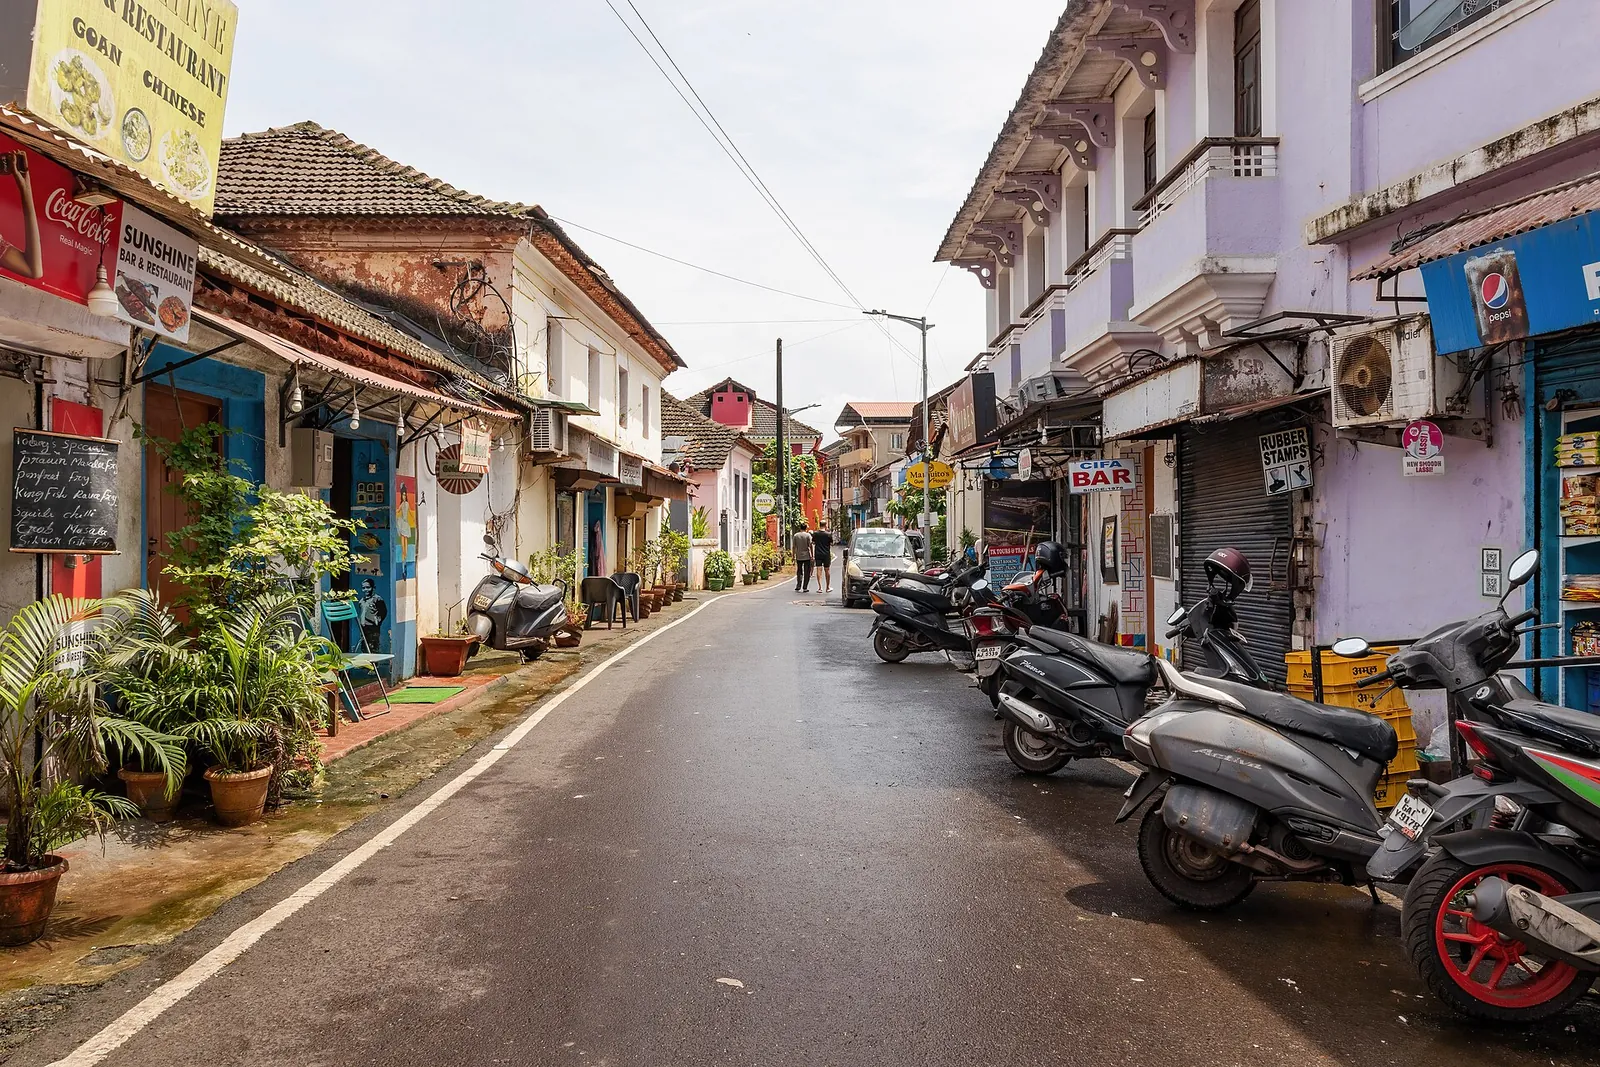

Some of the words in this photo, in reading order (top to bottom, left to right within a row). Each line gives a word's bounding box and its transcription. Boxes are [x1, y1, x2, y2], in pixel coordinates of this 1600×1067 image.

[72, 17, 123, 67] GOAN
[121, 0, 226, 98] RESTAURANT
[143, 70, 206, 129] CHINESE
[60, 234, 74, 247] Real
[74, 241, 93, 256] Magic
[123, 224, 195, 275] SUNSHINE
[119, 247, 137, 267] BAR
[138, 257, 145, 271] &
[146, 260, 193, 293] RESTAURANT
[1489, 308, 1512, 324] pepsi
[1260, 429, 1307, 451] RUBBER
[1079, 460, 1122, 470] CIFA
[1263, 444, 1307, 466] STAMPS
[910, 471, 950, 479] Maruito's
[1072, 469, 1132, 487] BAR
[1191, 748, 1262, 770] Activa
